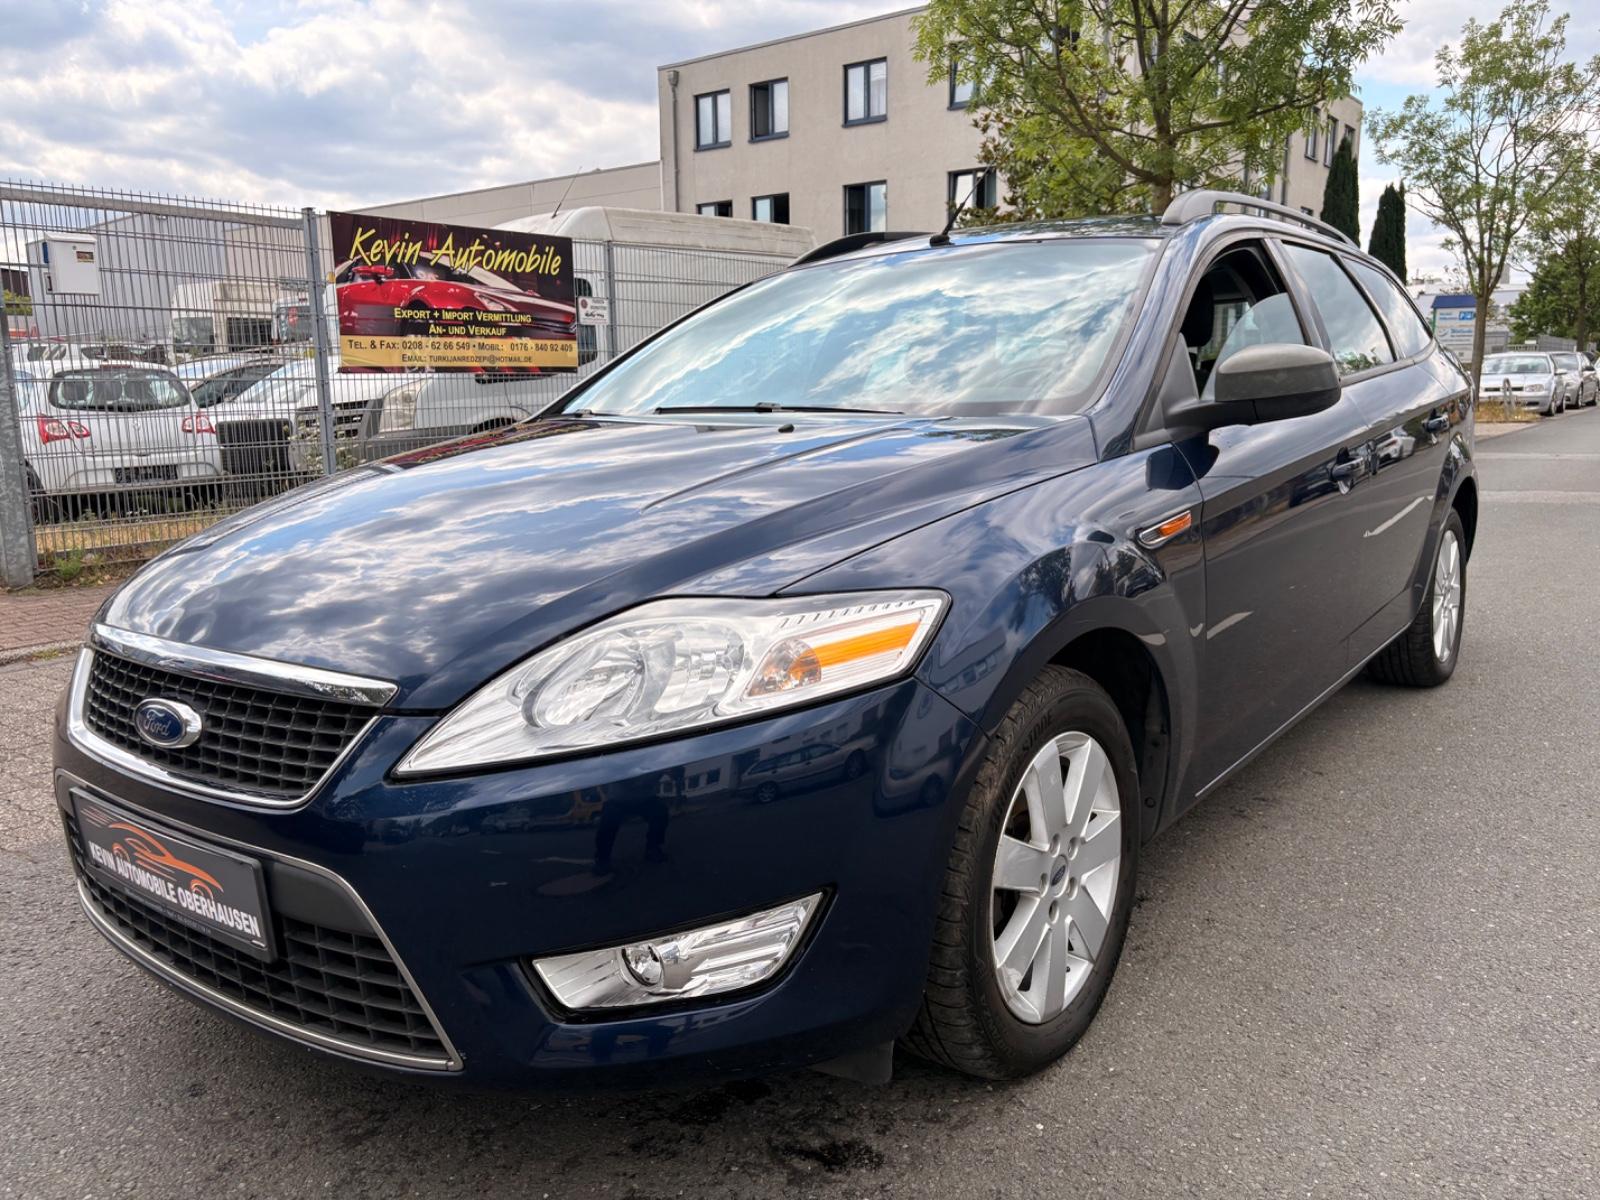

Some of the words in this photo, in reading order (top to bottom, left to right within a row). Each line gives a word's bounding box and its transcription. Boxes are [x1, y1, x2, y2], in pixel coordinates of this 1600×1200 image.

[349, 227, 422, 267] Kevin
[430, 232, 562, 276] Automobile
[394, 307, 431, 319] EXPORT
[442, 309, 474, 321] IMPORT
[475, 310, 532, 323] VERMITTLUNG
[468, 325, 508, 336] VERKAUF
[369, 340, 377, 349] &
[401, 340, 423, 350] 0208
[431, 341, 441, 350] 62
[455, 342, 471, 351] 549
[510, 342, 529, 351] 0176
[143, 709, 172, 737] Ford
[88, 840, 118, 872] KEVIN
[116, 855, 178, 904] AUTOMOBILE
[177, 886, 262, 938] OBERHAUSEN
